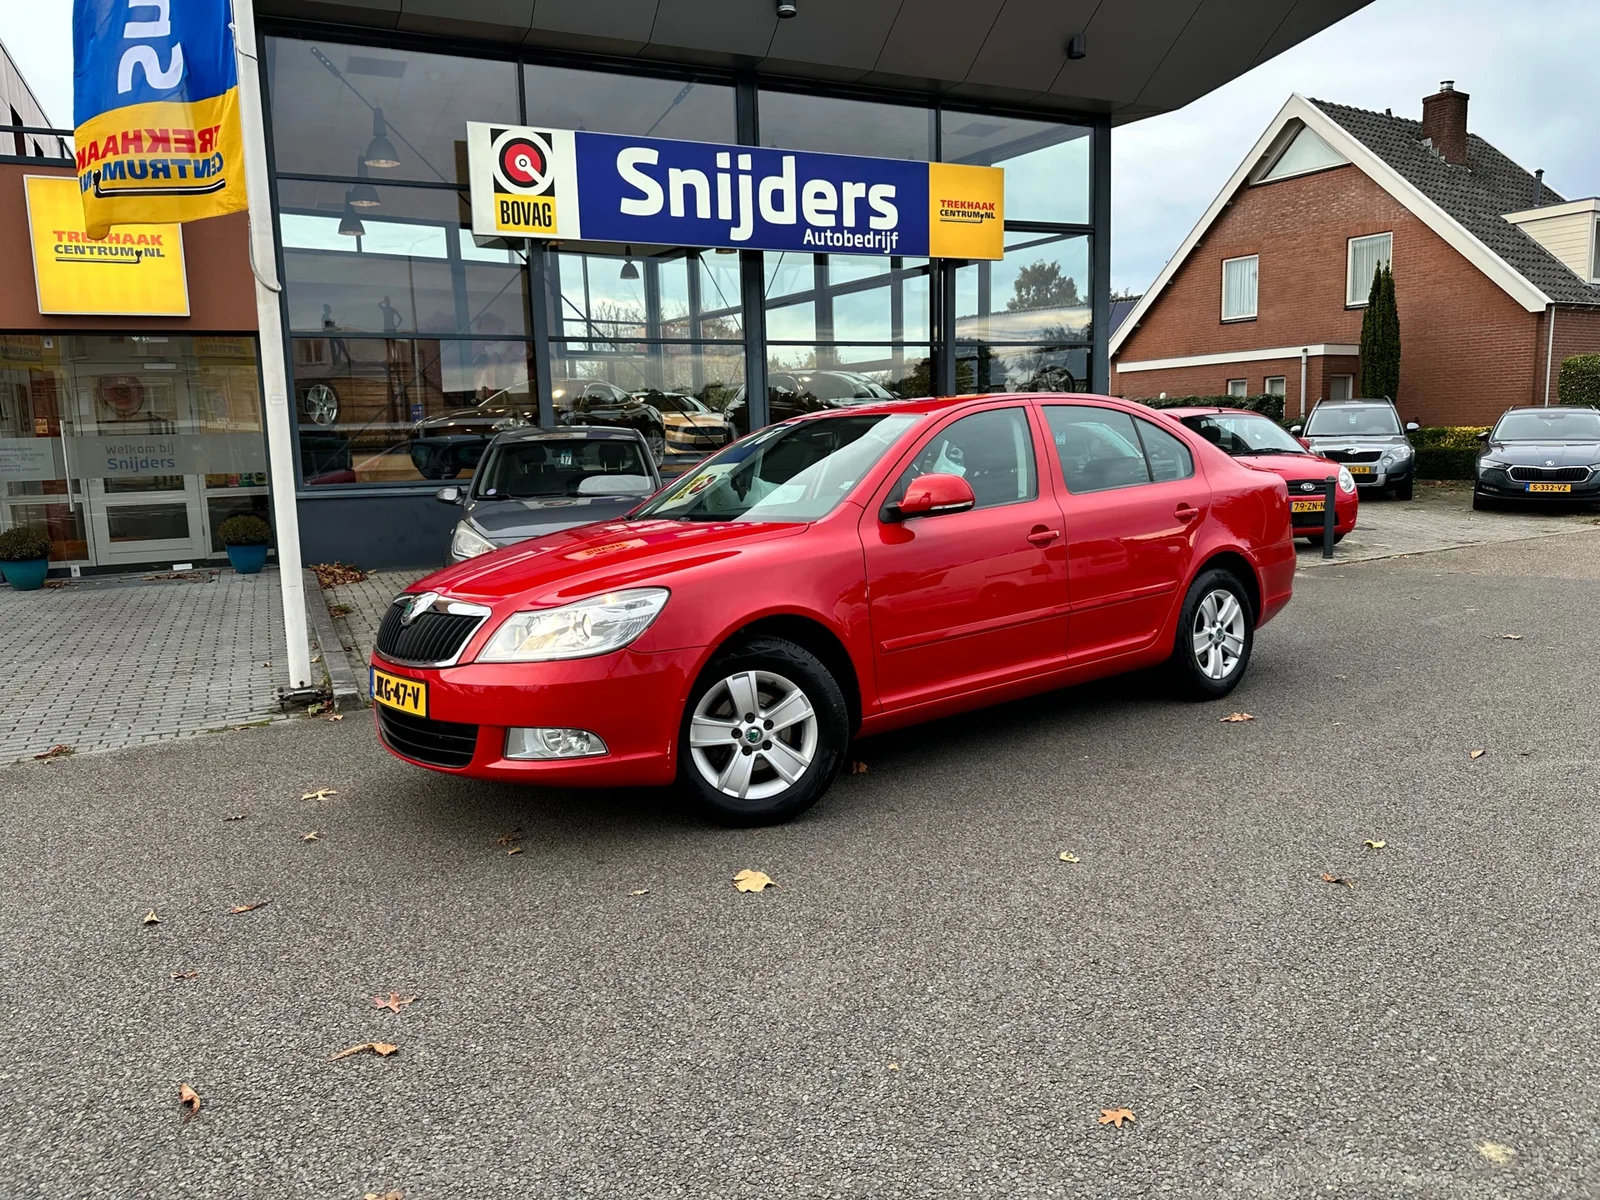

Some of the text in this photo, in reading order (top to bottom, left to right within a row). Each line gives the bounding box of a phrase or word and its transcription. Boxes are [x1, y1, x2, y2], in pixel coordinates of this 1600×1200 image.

[616, 146, 899, 242] Snijders
[499, 200, 553, 228] BOVAG
[940, 199, 996, 211] TREKHAAK
[52, 230, 164, 246] TREHAAK
[802, 228, 900, 254] Autobedrijf
[105, 443, 175, 456] Welkom bij
[106, 456, 176, 473] Snijders
[376, 674, 420, 710] JKG-47-V
